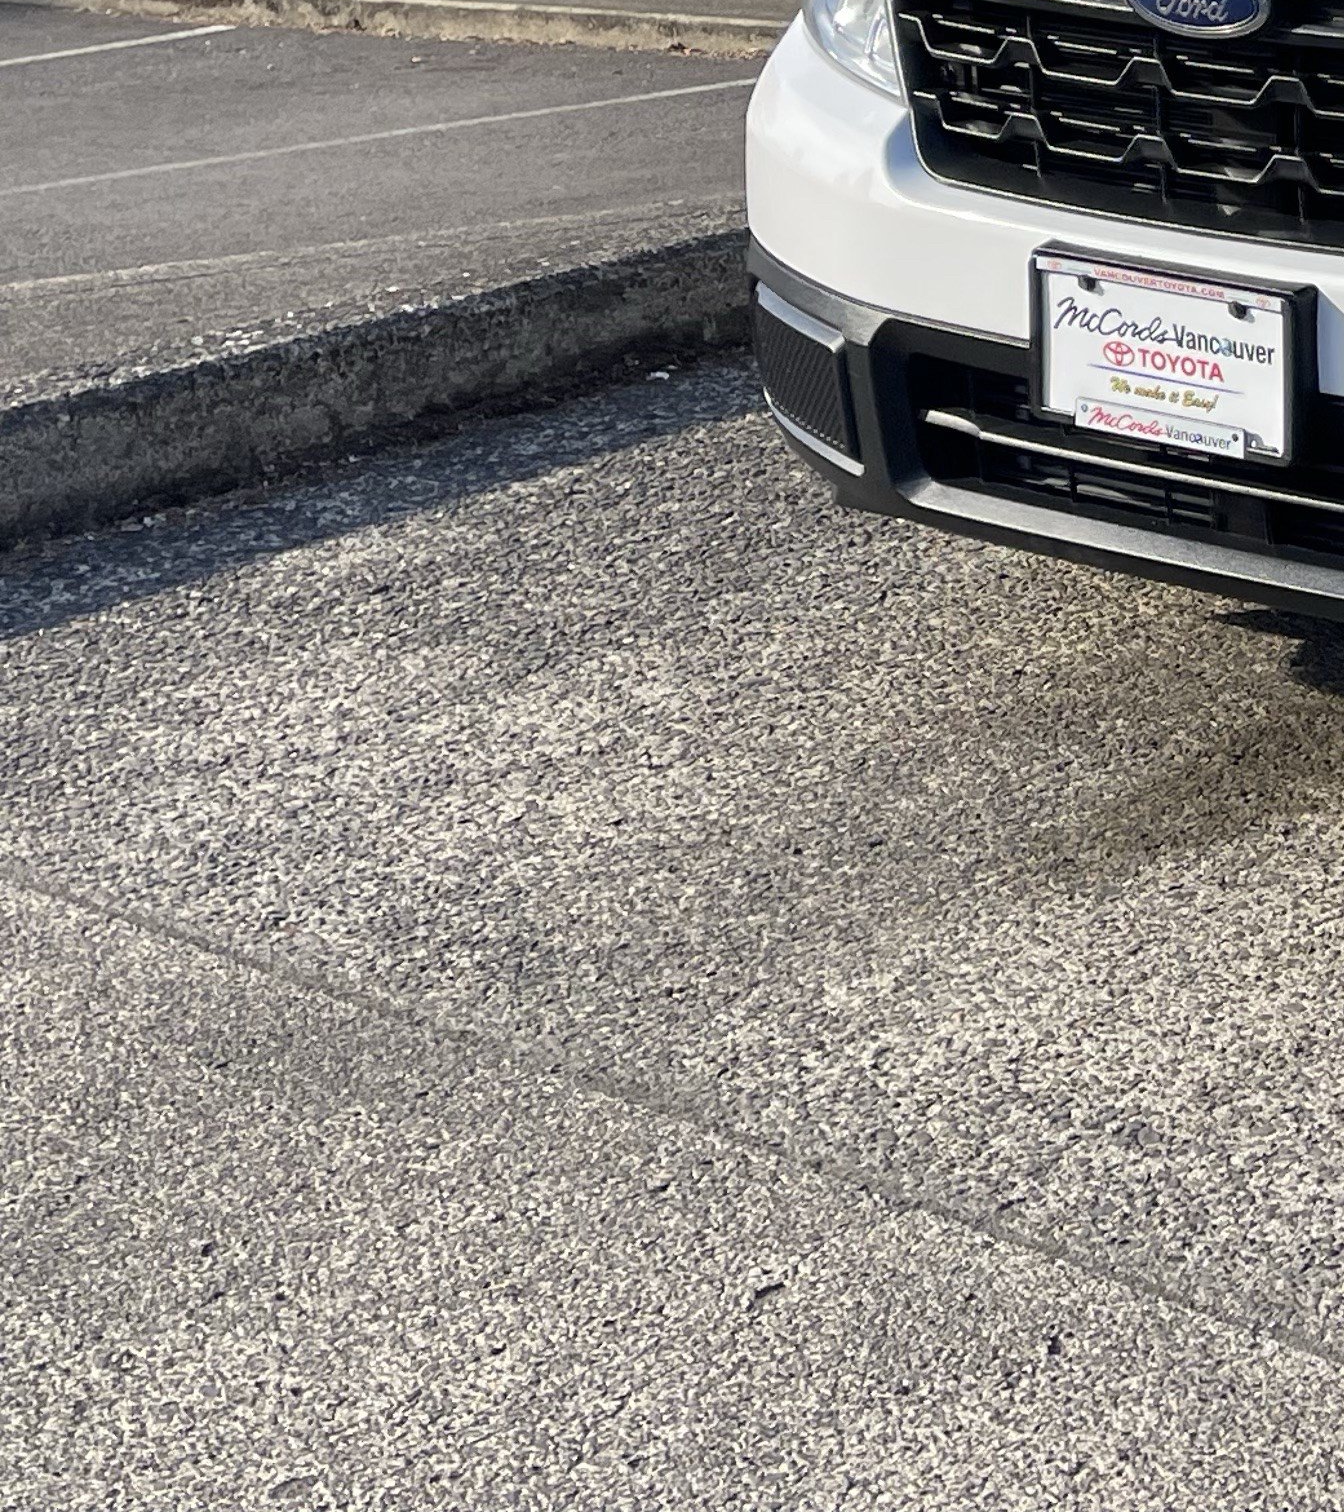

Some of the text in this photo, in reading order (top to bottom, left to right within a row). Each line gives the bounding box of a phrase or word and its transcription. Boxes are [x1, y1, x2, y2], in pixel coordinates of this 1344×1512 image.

[1094, 268, 1225, 299] VANCOUVERTOYOTA.COM
[1054, 296, 1276, 365] McCords Vancouver
[1138, 348, 1225, 383] TOYOTA
[1110, 375, 1219, 414] We make it Easy!
[1088, 405, 1232, 450] McCords Vancouver
